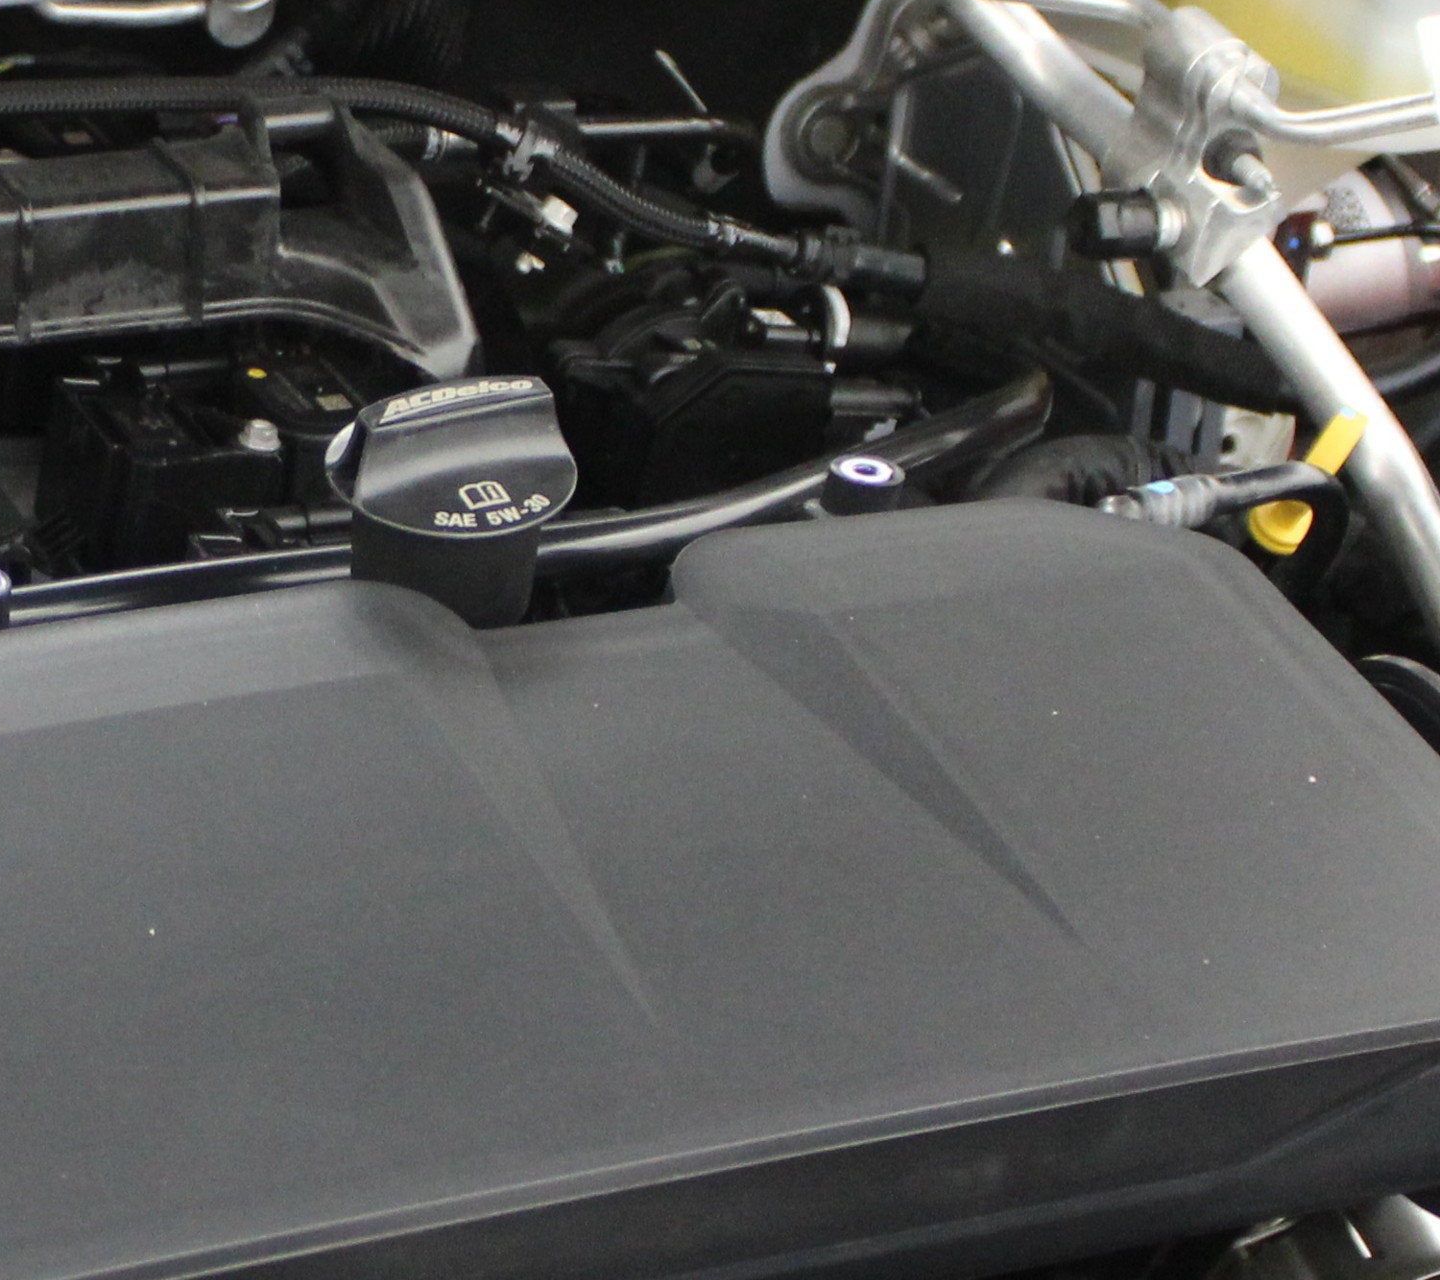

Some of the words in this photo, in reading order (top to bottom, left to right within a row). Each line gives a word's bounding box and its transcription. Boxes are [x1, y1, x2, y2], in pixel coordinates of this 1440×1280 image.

[383, 380, 533, 416] ACDelco
[434, 511, 478, 527] SAE
[486, 494, 551, 525] 5W-30
